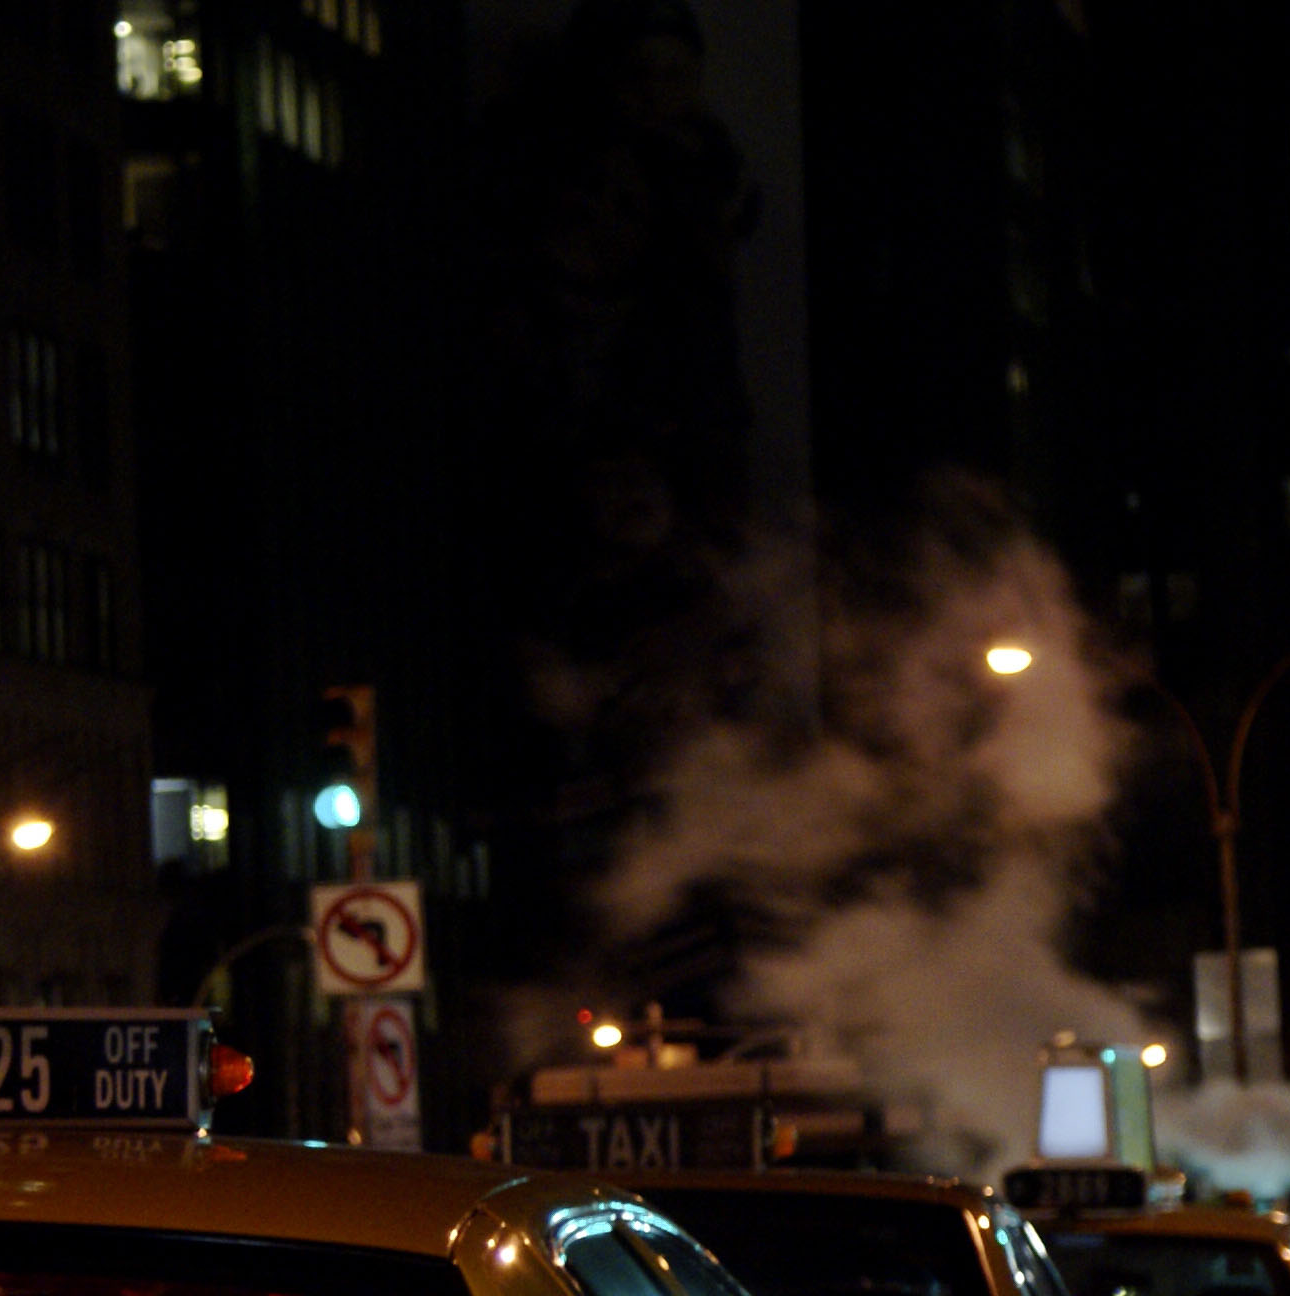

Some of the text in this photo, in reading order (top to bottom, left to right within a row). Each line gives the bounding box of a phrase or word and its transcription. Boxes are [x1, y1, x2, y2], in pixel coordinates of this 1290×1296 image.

[103, 1025, 159, 1066] OFF
[94, 1068, 168, 1111] DUTY
[579, 1115, 681, 1174] TAXI
